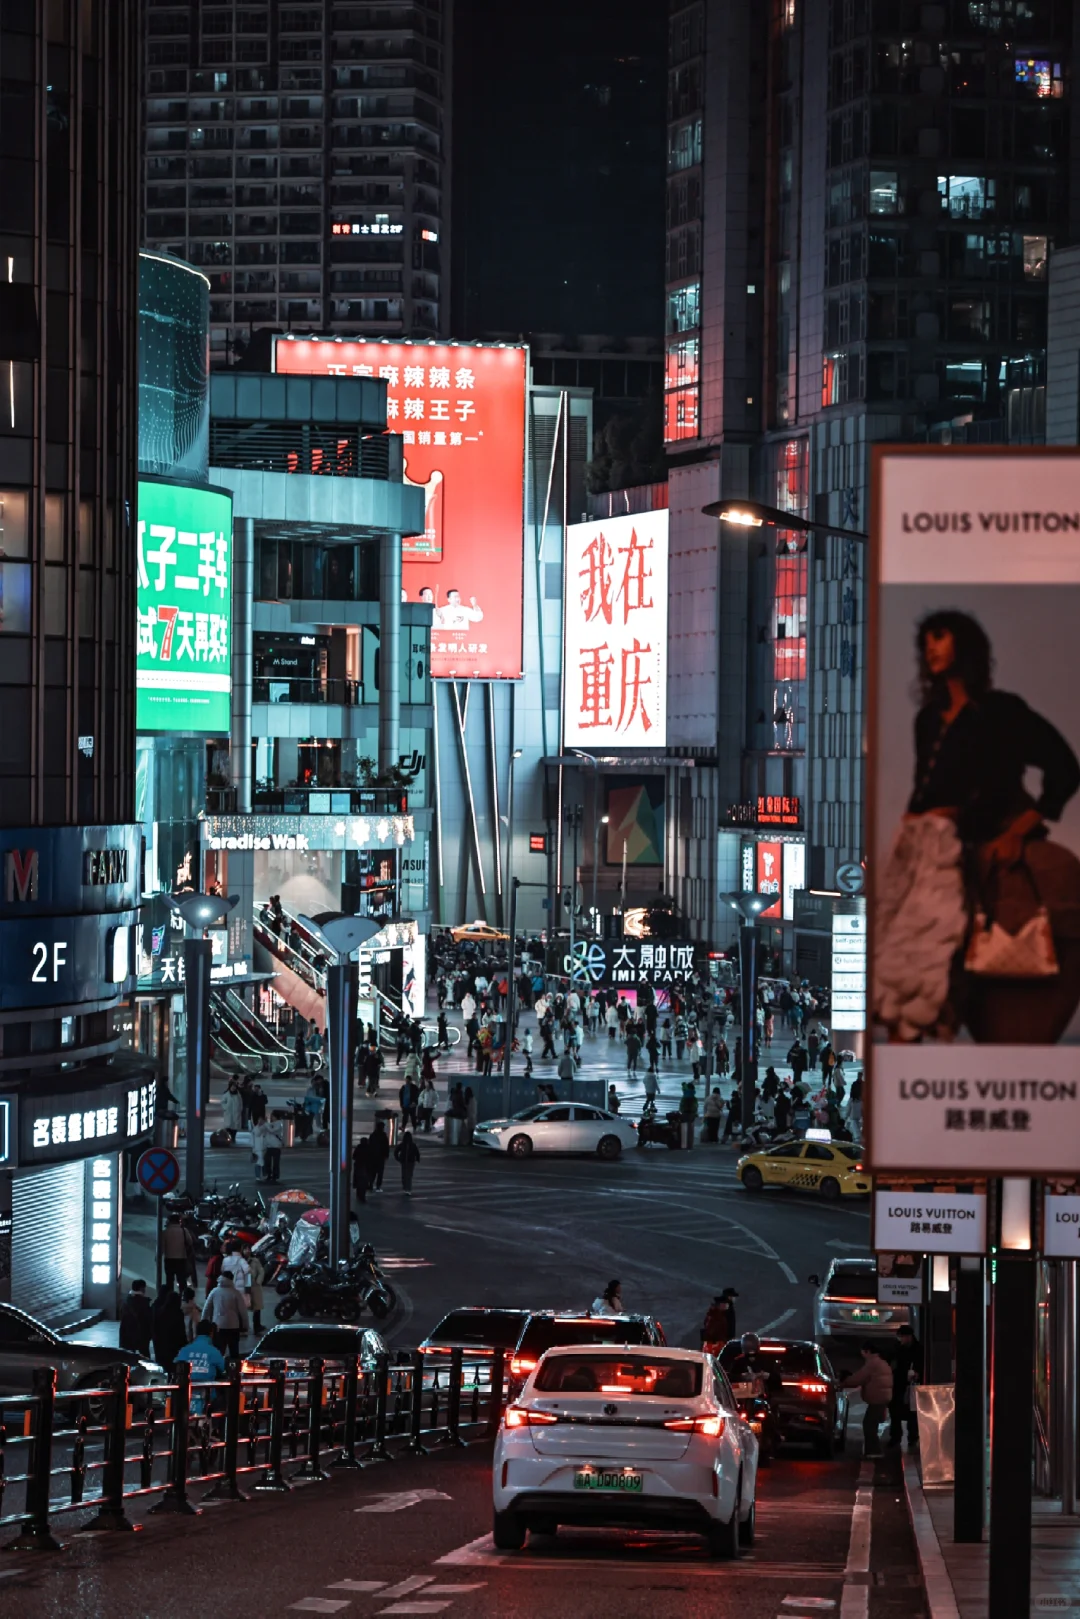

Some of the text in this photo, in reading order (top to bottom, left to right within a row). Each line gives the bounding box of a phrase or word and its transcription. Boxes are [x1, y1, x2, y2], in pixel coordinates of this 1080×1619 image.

[902, 511, 1080, 533] LOUIS VUITTON
[578, 526, 654, 626] 我在
[578, 637, 653, 735] 重庆
[271, 834, 309, 849] Walk
[31, 941, 67, 982] 2F
[613, 945, 694, 968] 大融城
[900, 1079, 1077, 1100] LOUIS VUITTON
[888, 1207, 975, 1219] LOUIS VUITTON
[910, 1222, 952, 1234] 路易威登
